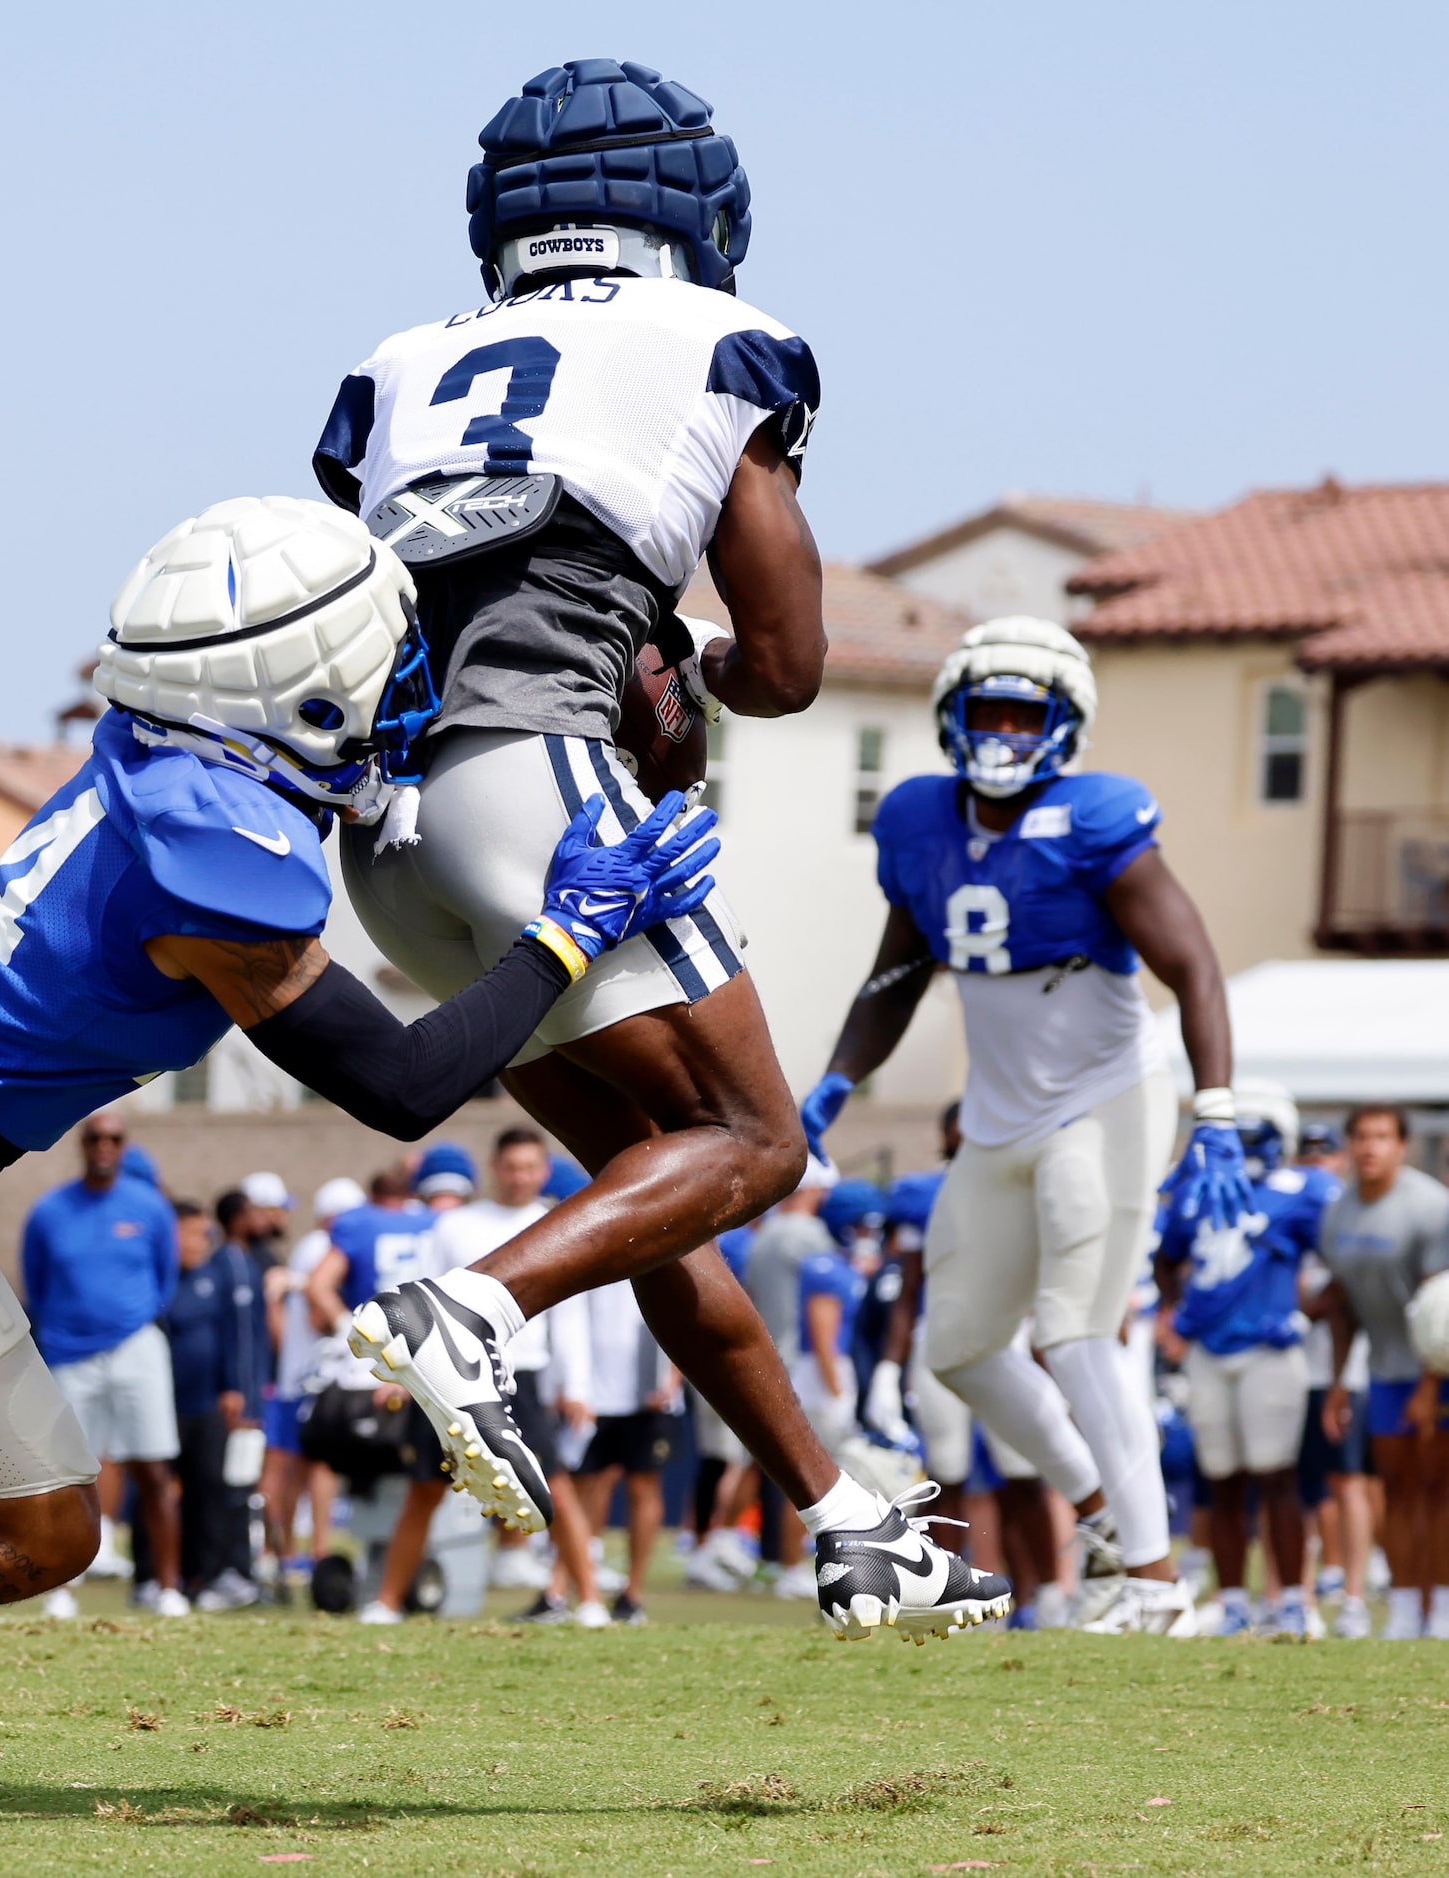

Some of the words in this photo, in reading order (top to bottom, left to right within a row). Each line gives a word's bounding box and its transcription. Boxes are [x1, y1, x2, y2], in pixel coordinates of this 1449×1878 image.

[529, 237, 605, 257] COWBOYS
[428, 335, 562, 476] 3
[660, 694, 687, 737] NFL
[943, 883, 1013, 976] 8
